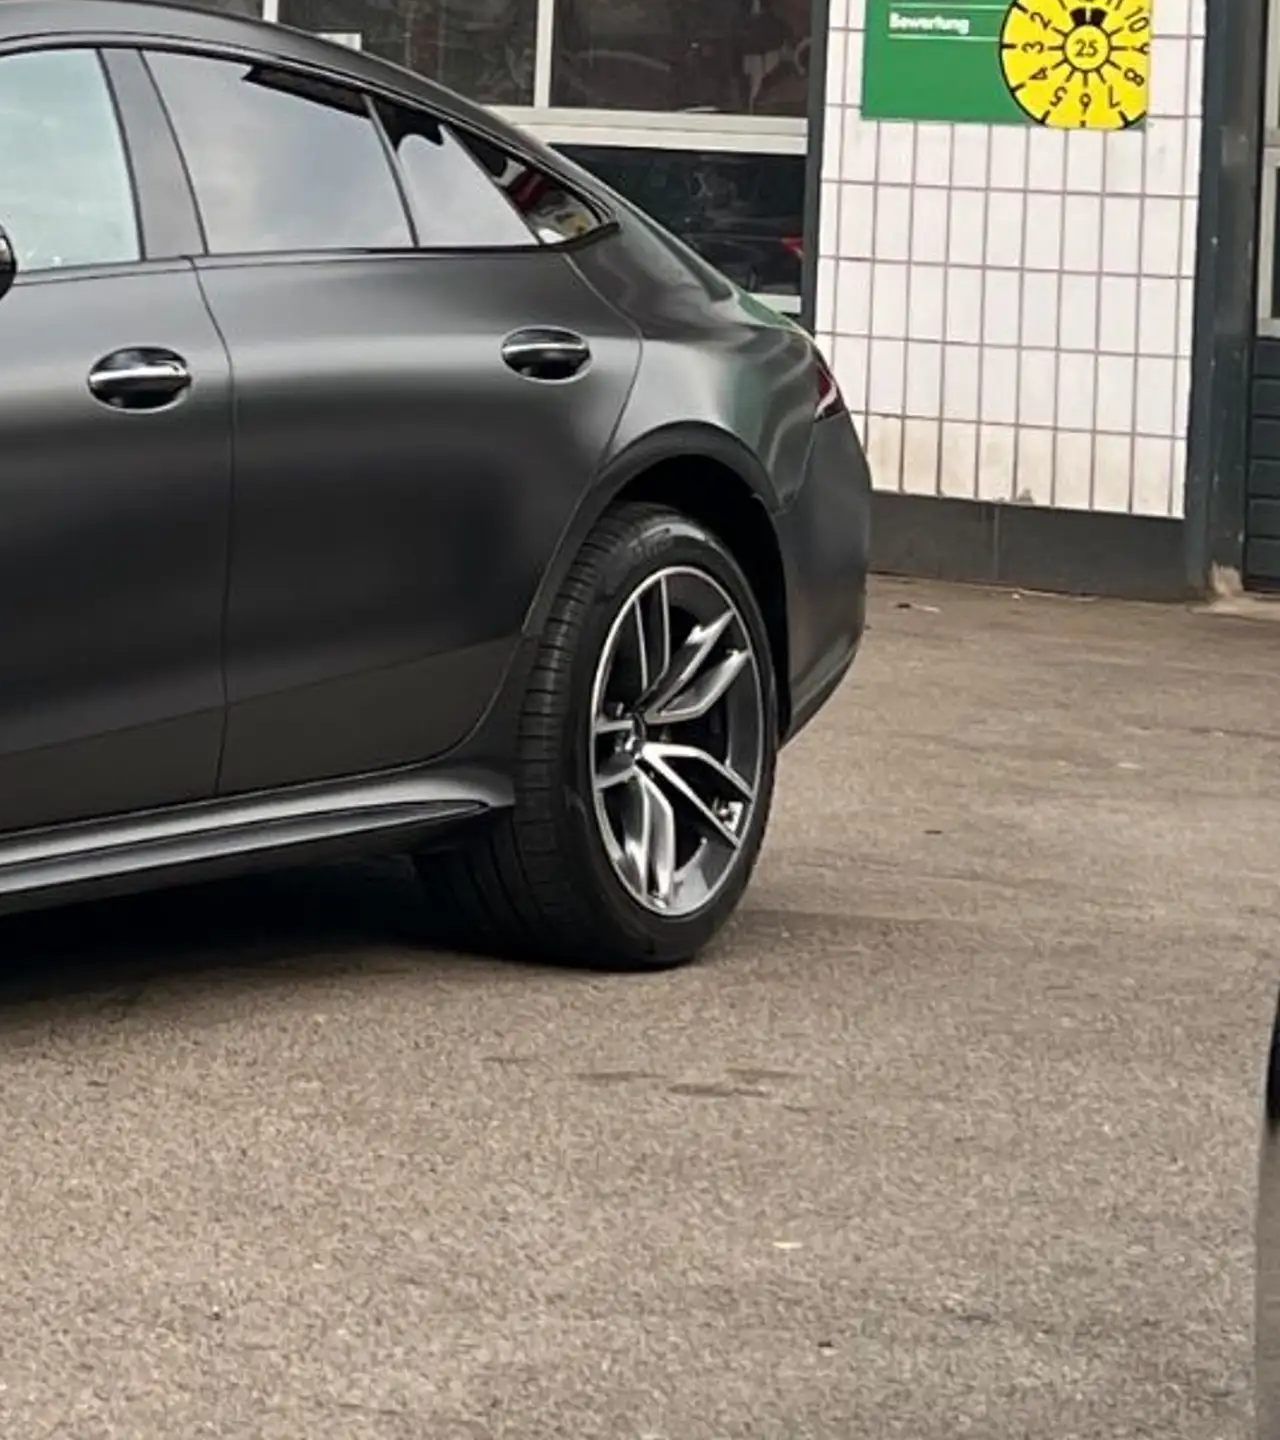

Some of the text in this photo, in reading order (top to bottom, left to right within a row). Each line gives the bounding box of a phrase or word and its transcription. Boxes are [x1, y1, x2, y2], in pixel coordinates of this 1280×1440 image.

[1030, 11, 1051, 30] 2
[1125, 7, 1150, 33] 10
[1021, 40, 1045, 54] 3
[1074, 39, 1099, 58] 25
[1028, 67, 1049, 82] 4
[1124, 67, 1145, 87] 8
[1049, 86, 1068, 108] 5
